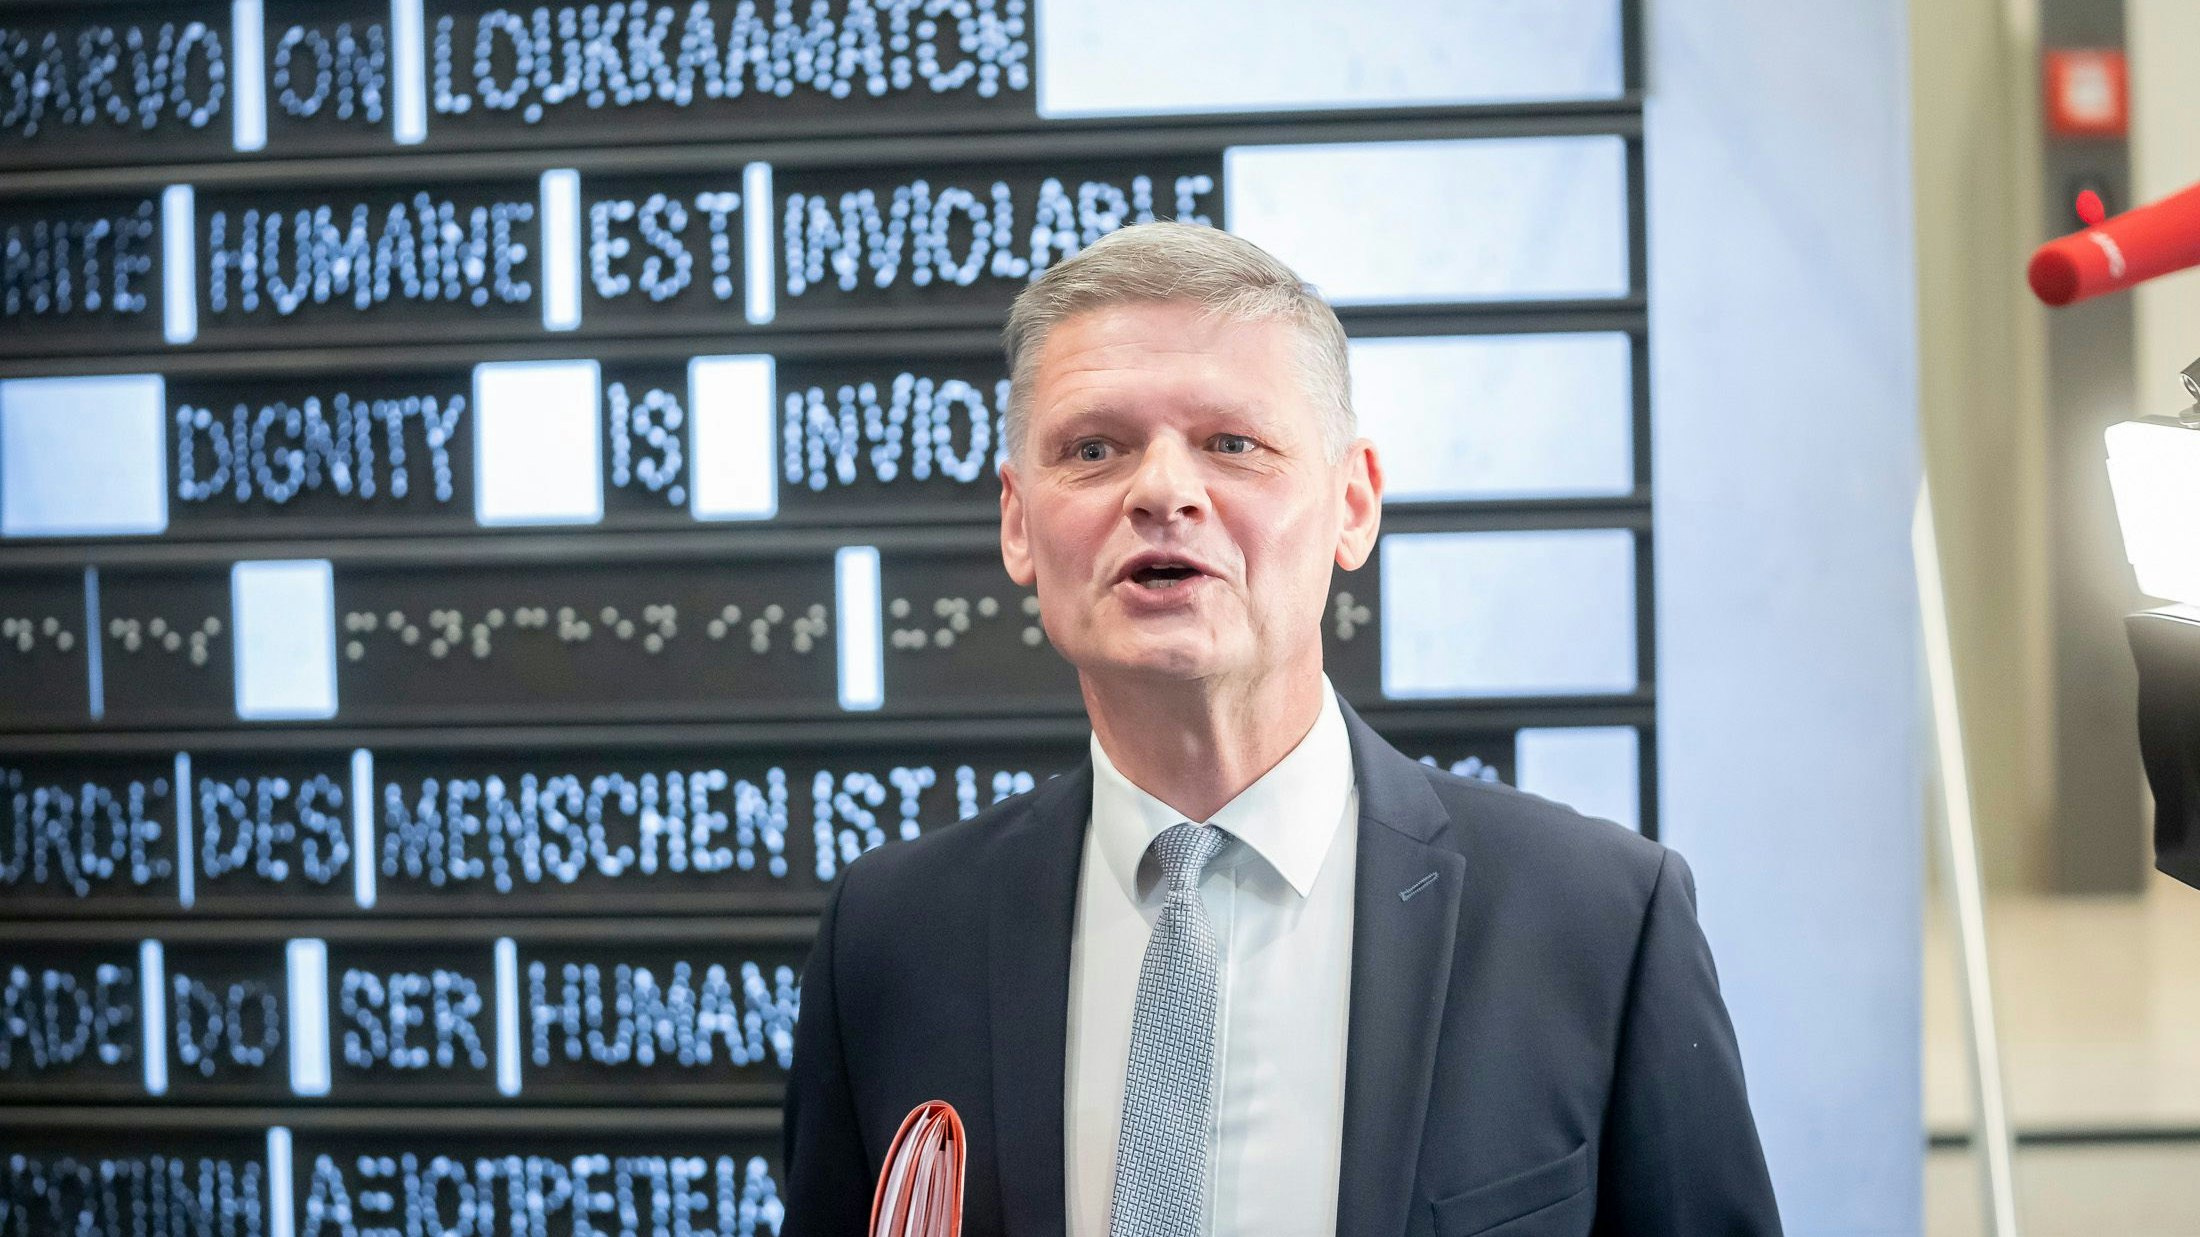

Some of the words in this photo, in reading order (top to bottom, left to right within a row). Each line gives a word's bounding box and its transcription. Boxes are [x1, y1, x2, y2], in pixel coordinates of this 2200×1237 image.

[274, 24, 386, 121] ON
[589, 193, 741, 301] EST
[176, 393, 466, 502] DIGNITY
[608, 382, 686, 505] IS
[200, 773, 350, 884] DES
[382, 767, 790, 893] MENSCHEN
[812, 765, 937, 882] IST
[173, 973, 281, 1077] DO
[341, 968, 488, 1070] SER
[528, 960, 801, 1070] HUMAN
